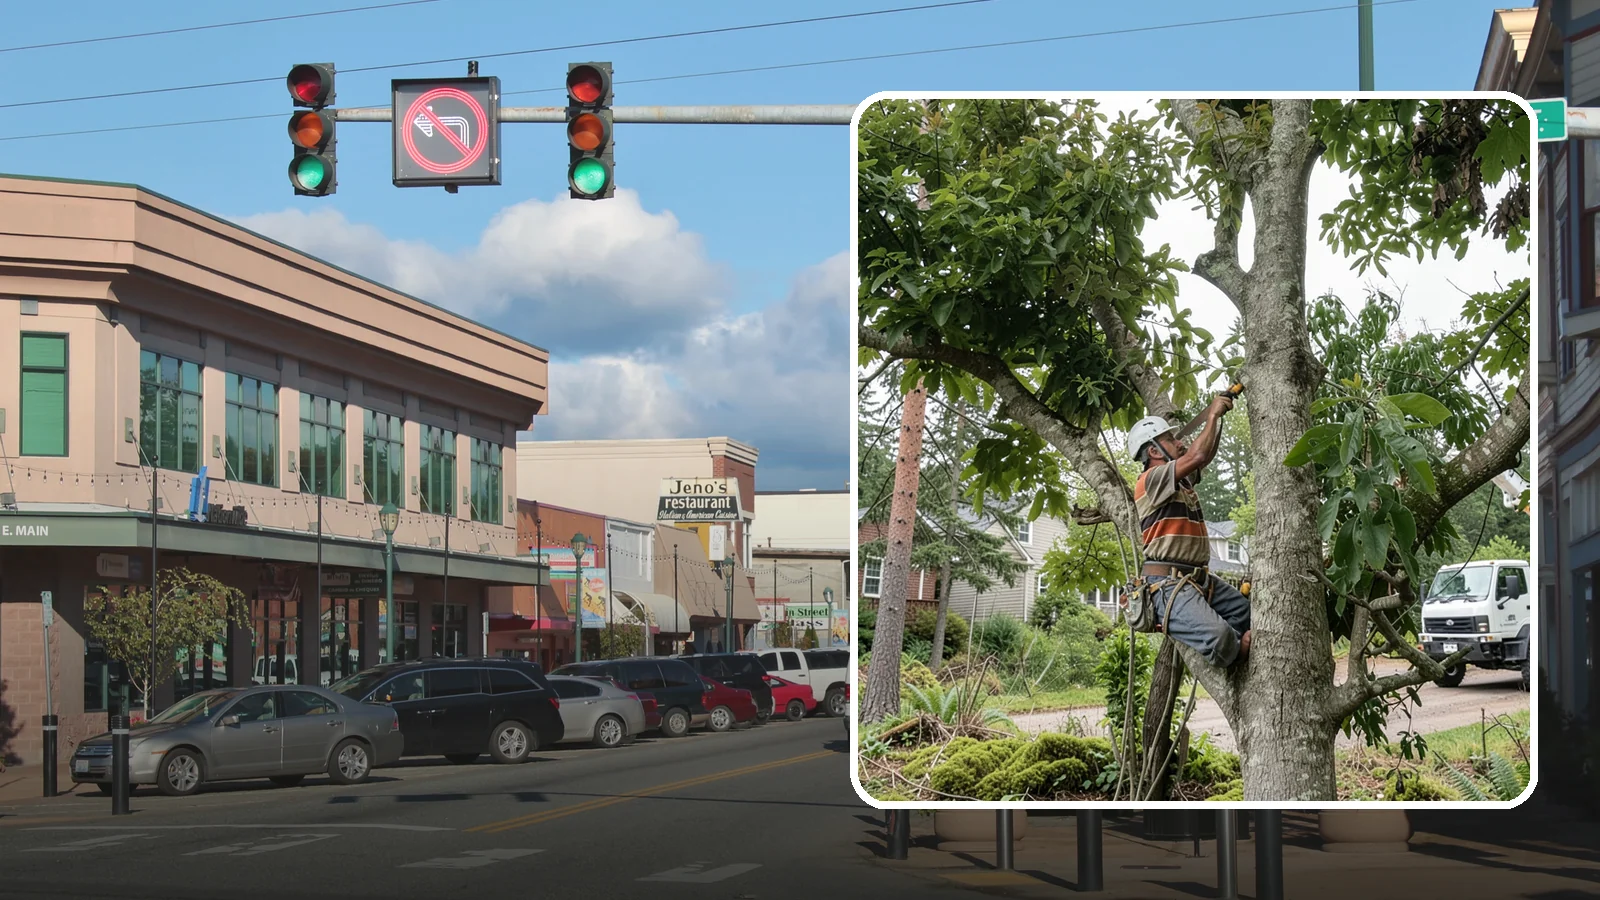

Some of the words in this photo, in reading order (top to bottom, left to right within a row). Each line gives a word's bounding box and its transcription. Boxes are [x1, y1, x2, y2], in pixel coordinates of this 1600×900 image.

[670, 480, 728, 494] Jeno's
[665, 496, 731, 509] restaurant
[659, 510, 681, 519] Italian
[686, 510, 714, 519] American
[715, 510, 737, 519] Cuisine
[2, 525, 13, 536] E.
[15, 525, 49, 536] MAIN
[797, 607, 829, 617] Street
